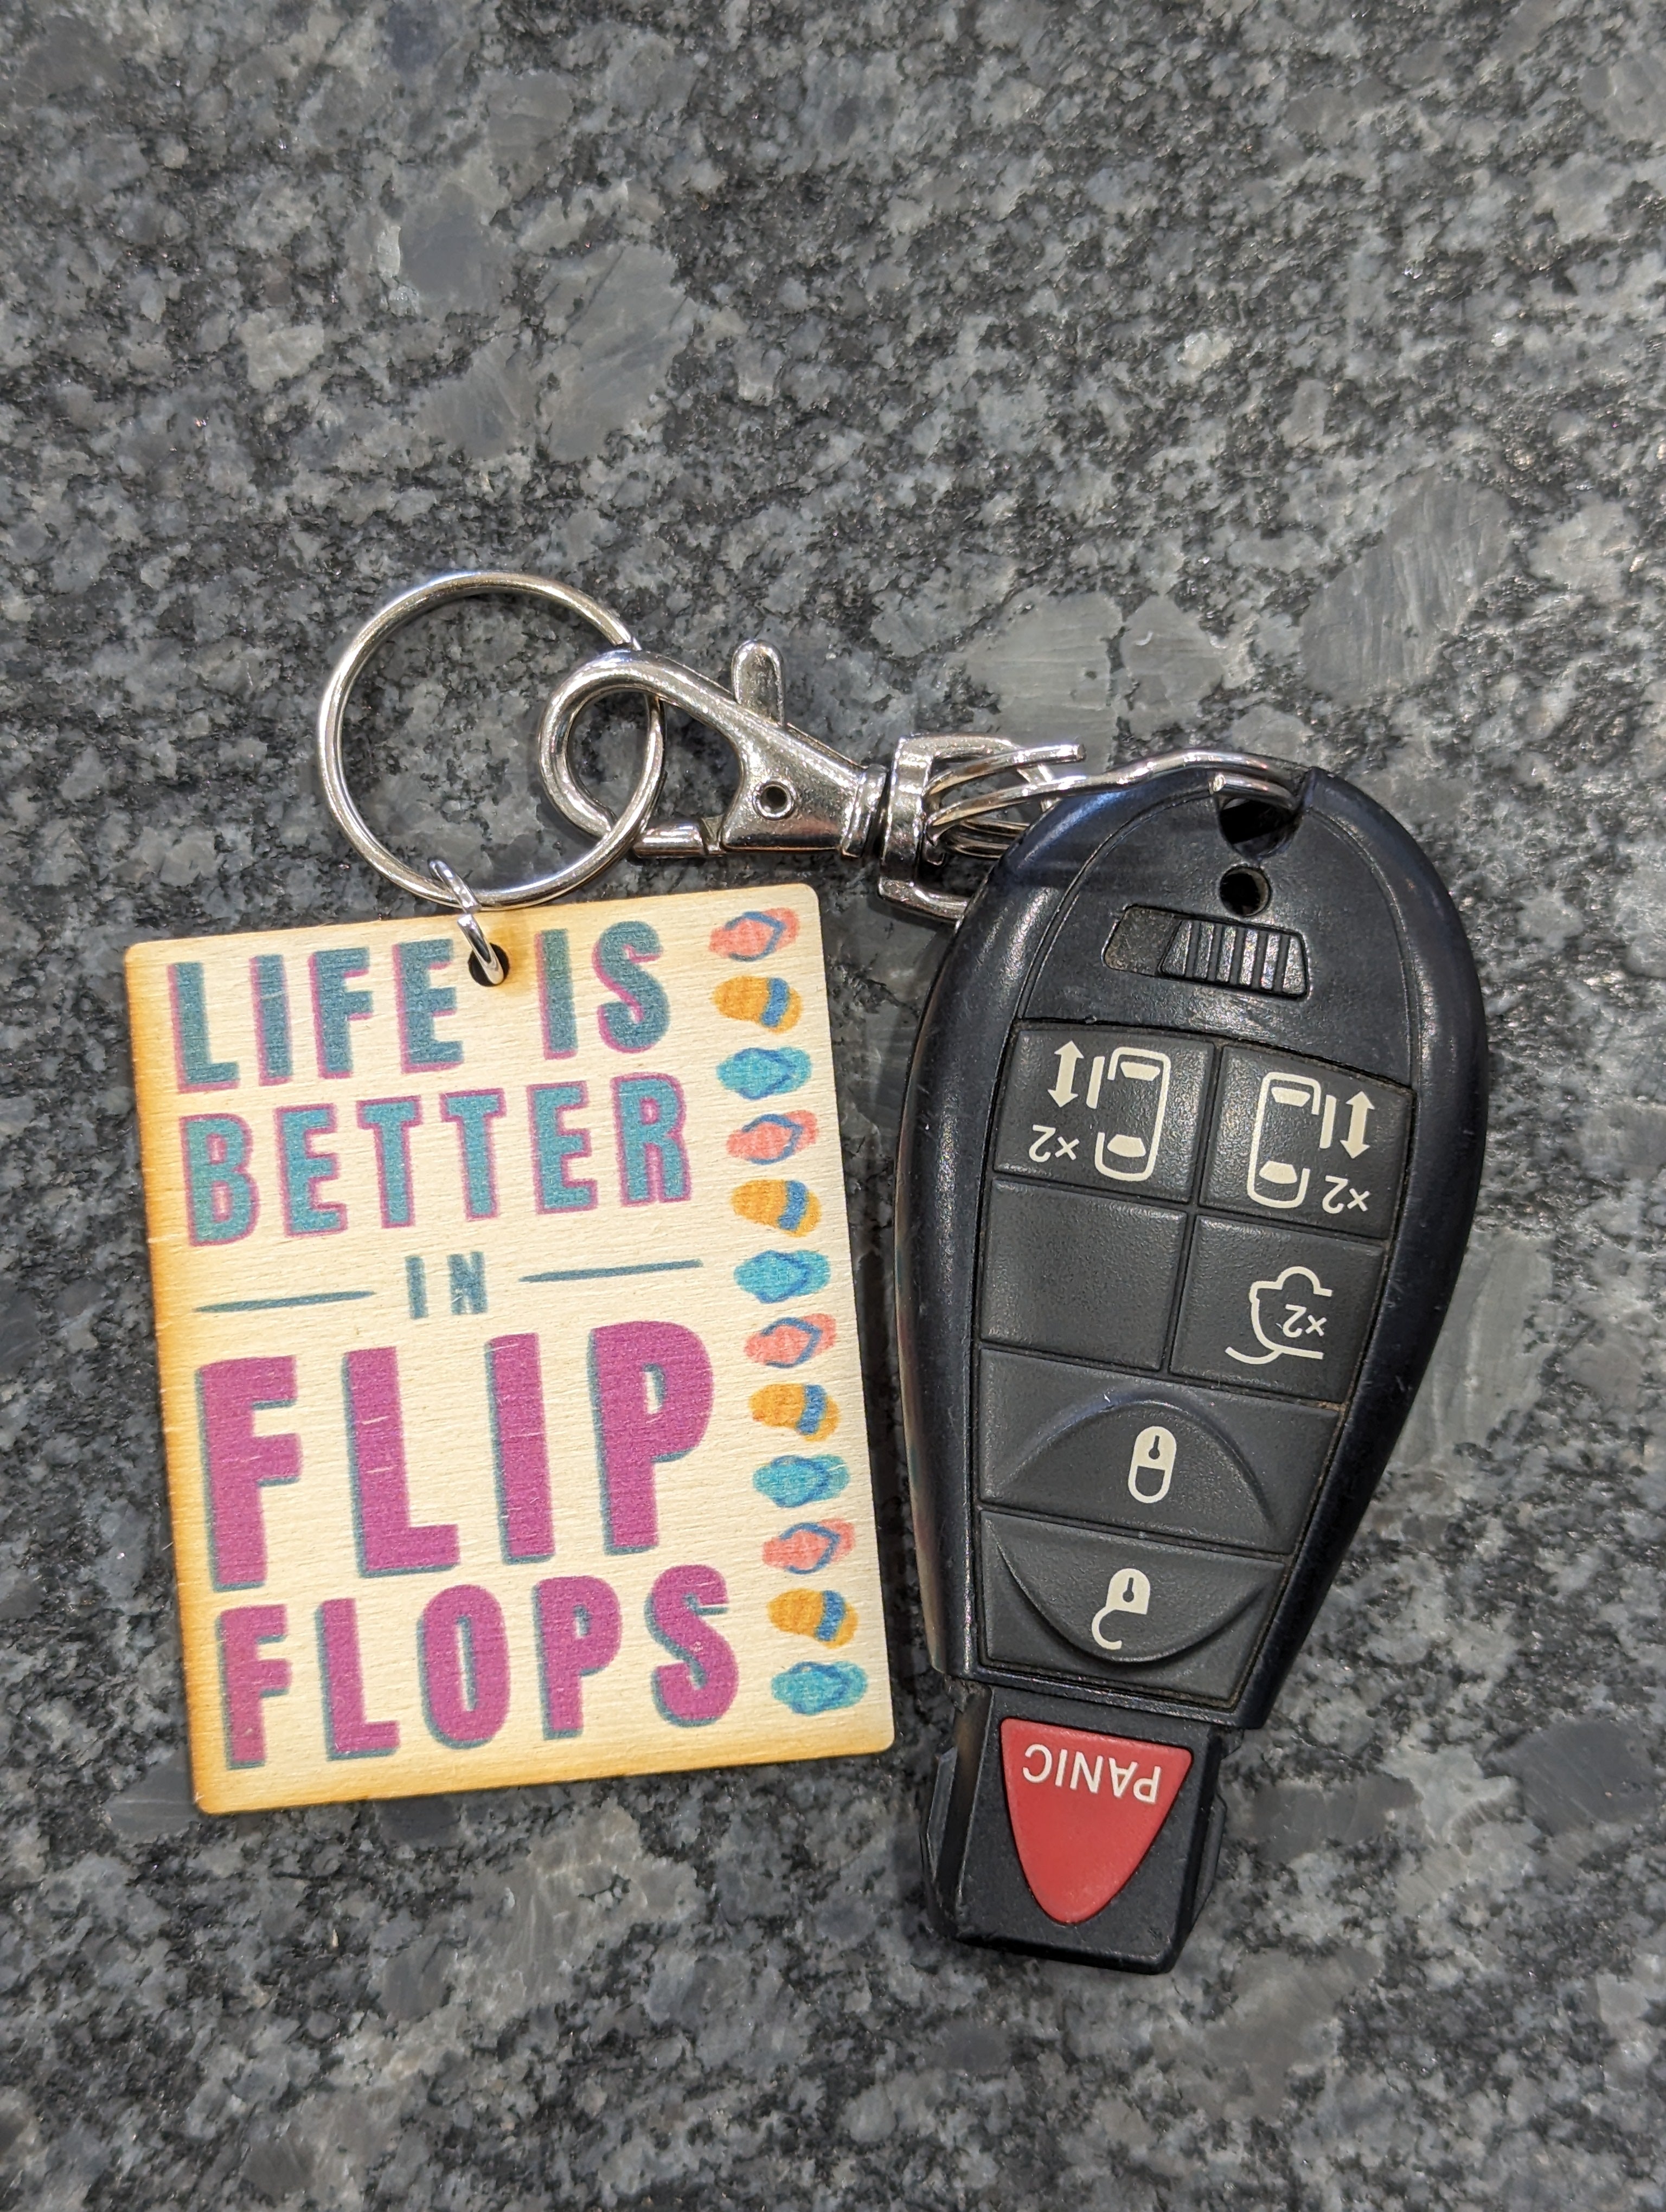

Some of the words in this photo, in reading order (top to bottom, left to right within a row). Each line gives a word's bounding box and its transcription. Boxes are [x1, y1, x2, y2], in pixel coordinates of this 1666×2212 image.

[167, 938, 464, 1094] LIFE
[535, 920, 672, 1060] IS
[179, 1072, 692, 1247] BETTER
[405, 1250, 489, 1320] IN
[195, 1319, 715, 1592] FLIP
[216, 1564, 740, 1770] FLOPS
[1022, 1743, 1162, 1804] PANIC
